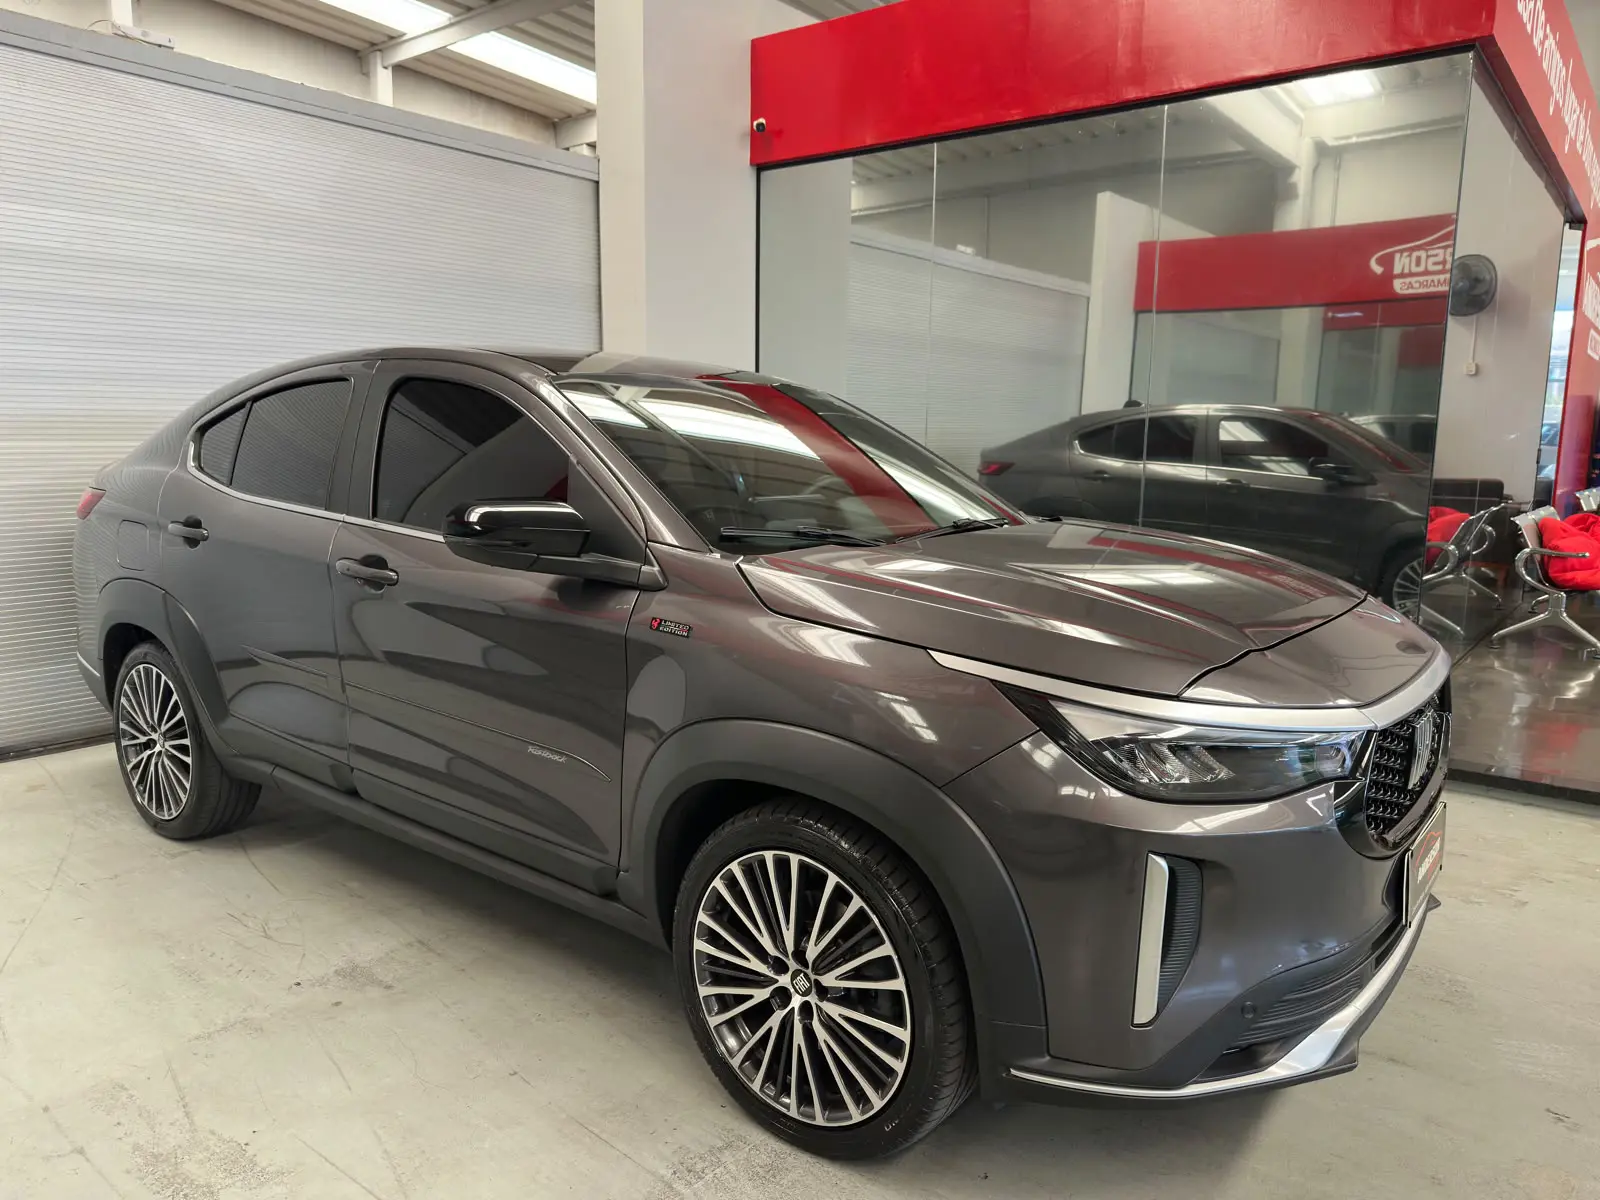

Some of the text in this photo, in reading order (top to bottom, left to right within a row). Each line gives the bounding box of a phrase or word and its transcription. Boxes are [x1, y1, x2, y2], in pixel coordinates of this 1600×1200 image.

[661, 620, 689, 631] LIMITED
[659, 627, 688, 636] EDITION
[793, 973, 810, 994] FIAT
